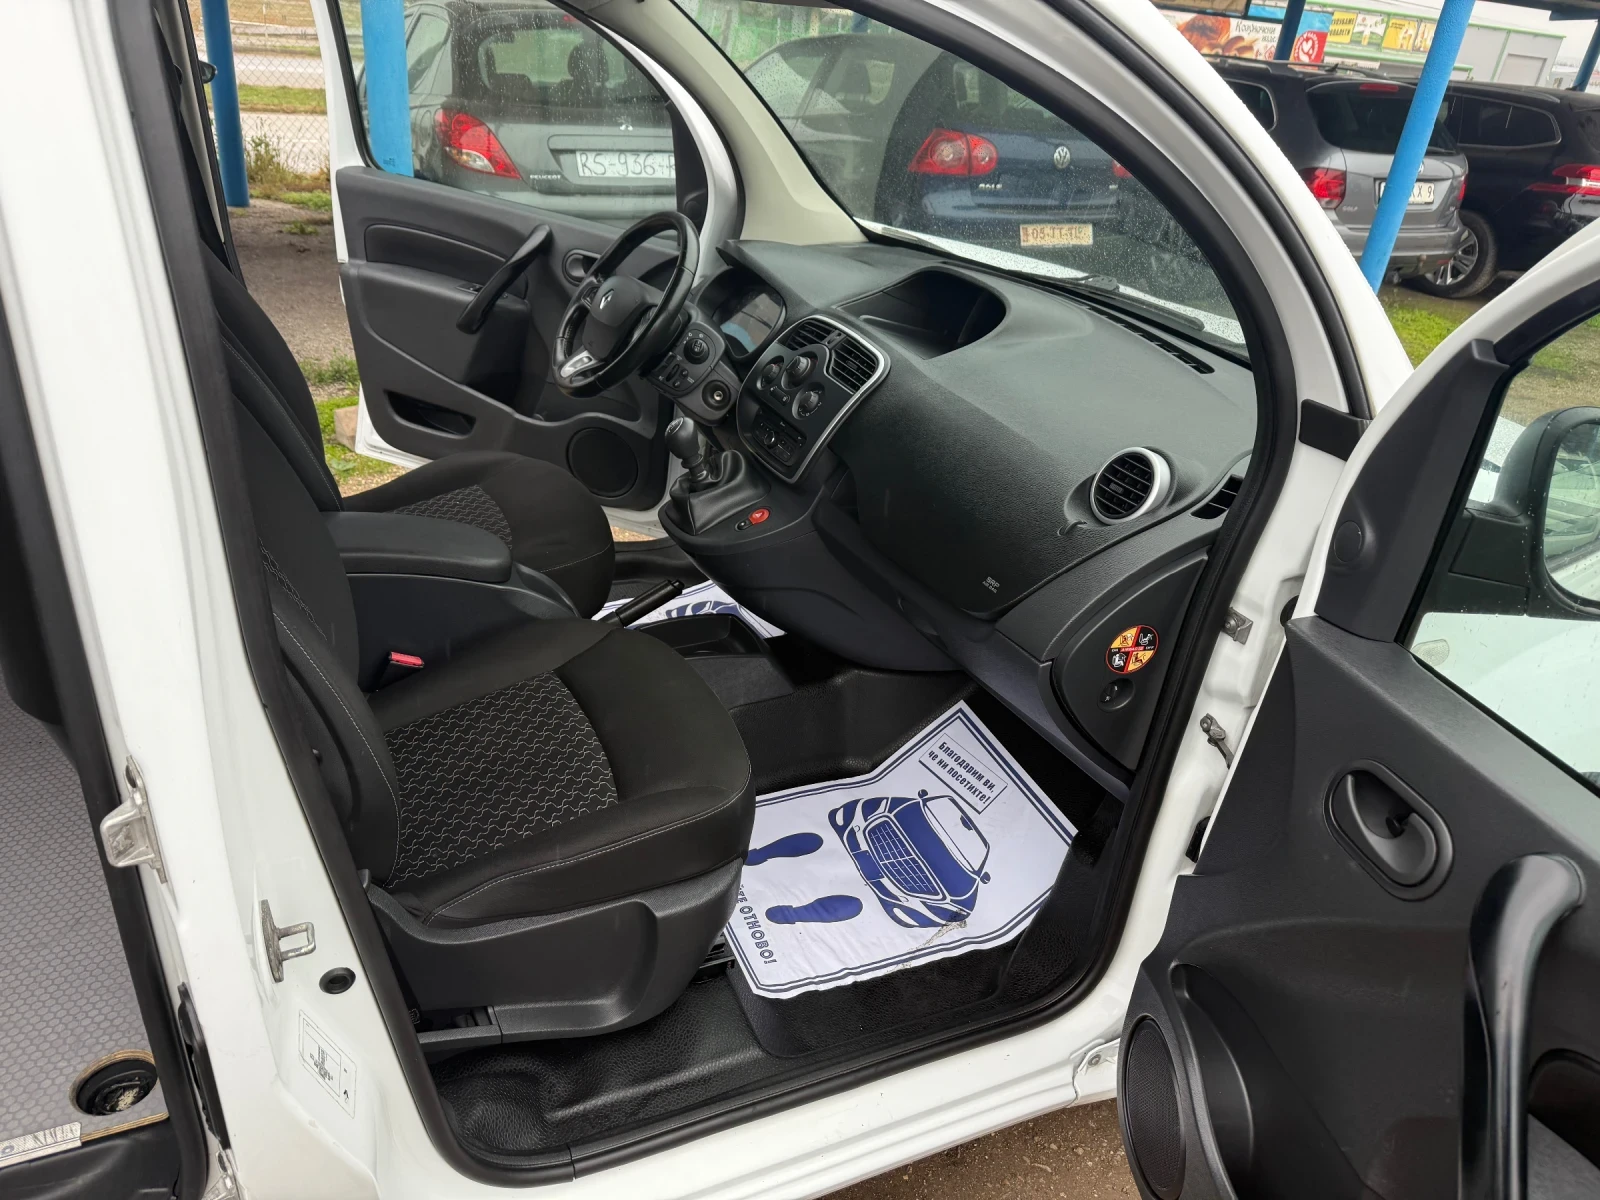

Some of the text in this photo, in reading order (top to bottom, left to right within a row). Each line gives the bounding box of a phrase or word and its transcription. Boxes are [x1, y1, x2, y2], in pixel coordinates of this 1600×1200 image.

[928, 750, 991, 804] че ни посетихте!
[938, 741, 985, 782] Благодарим
[739, 905, 778, 965] ОТНОВО!
